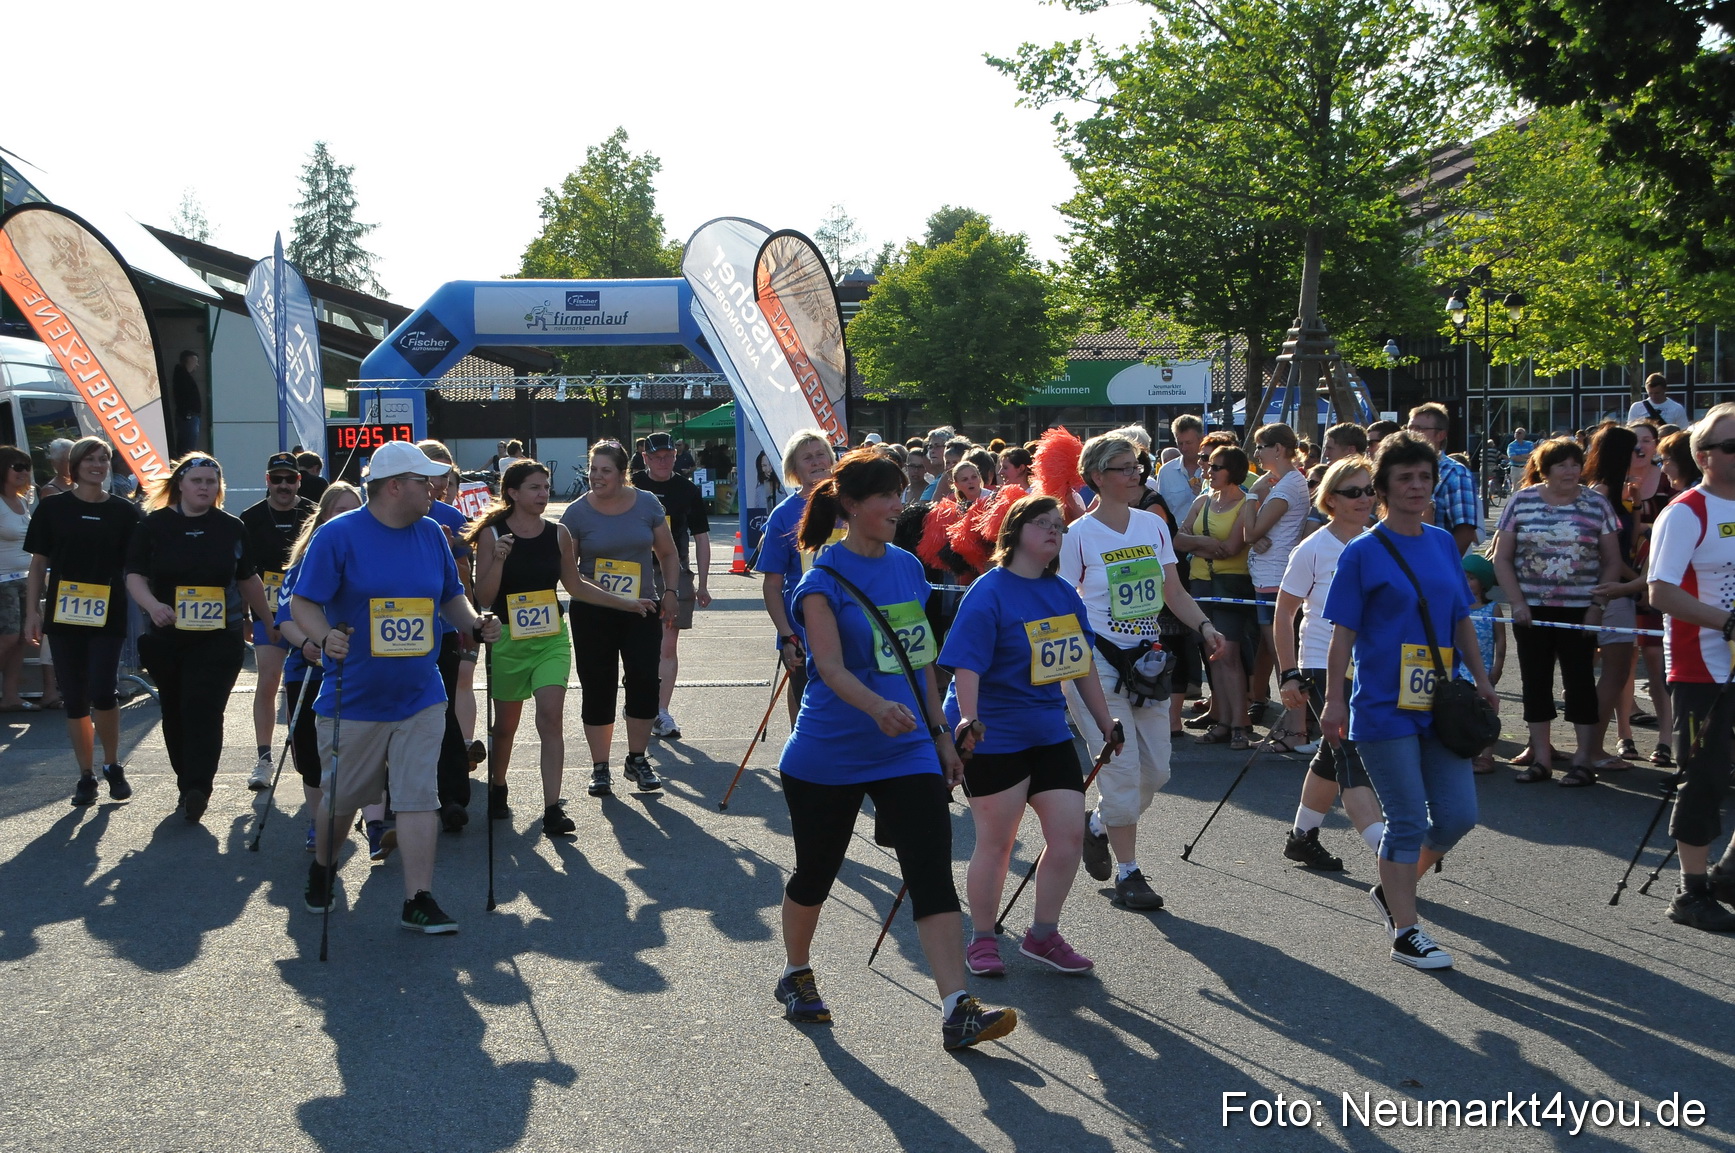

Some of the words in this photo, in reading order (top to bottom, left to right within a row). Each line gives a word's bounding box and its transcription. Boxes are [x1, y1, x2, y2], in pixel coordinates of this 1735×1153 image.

[554, 311, 629, 325] firmenlauf
[408, 338, 450, 346] Fischer
[600, 573, 633, 593] 672
[1118, 578, 1155, 606] 918
[59, 596, 105, 617] 1118
[178, 602, 223, 619] 1122
[516, 606, 550, 628] 621
[380, 618, 425, 642] 692
[1041, 636, 1083, 668] 675
